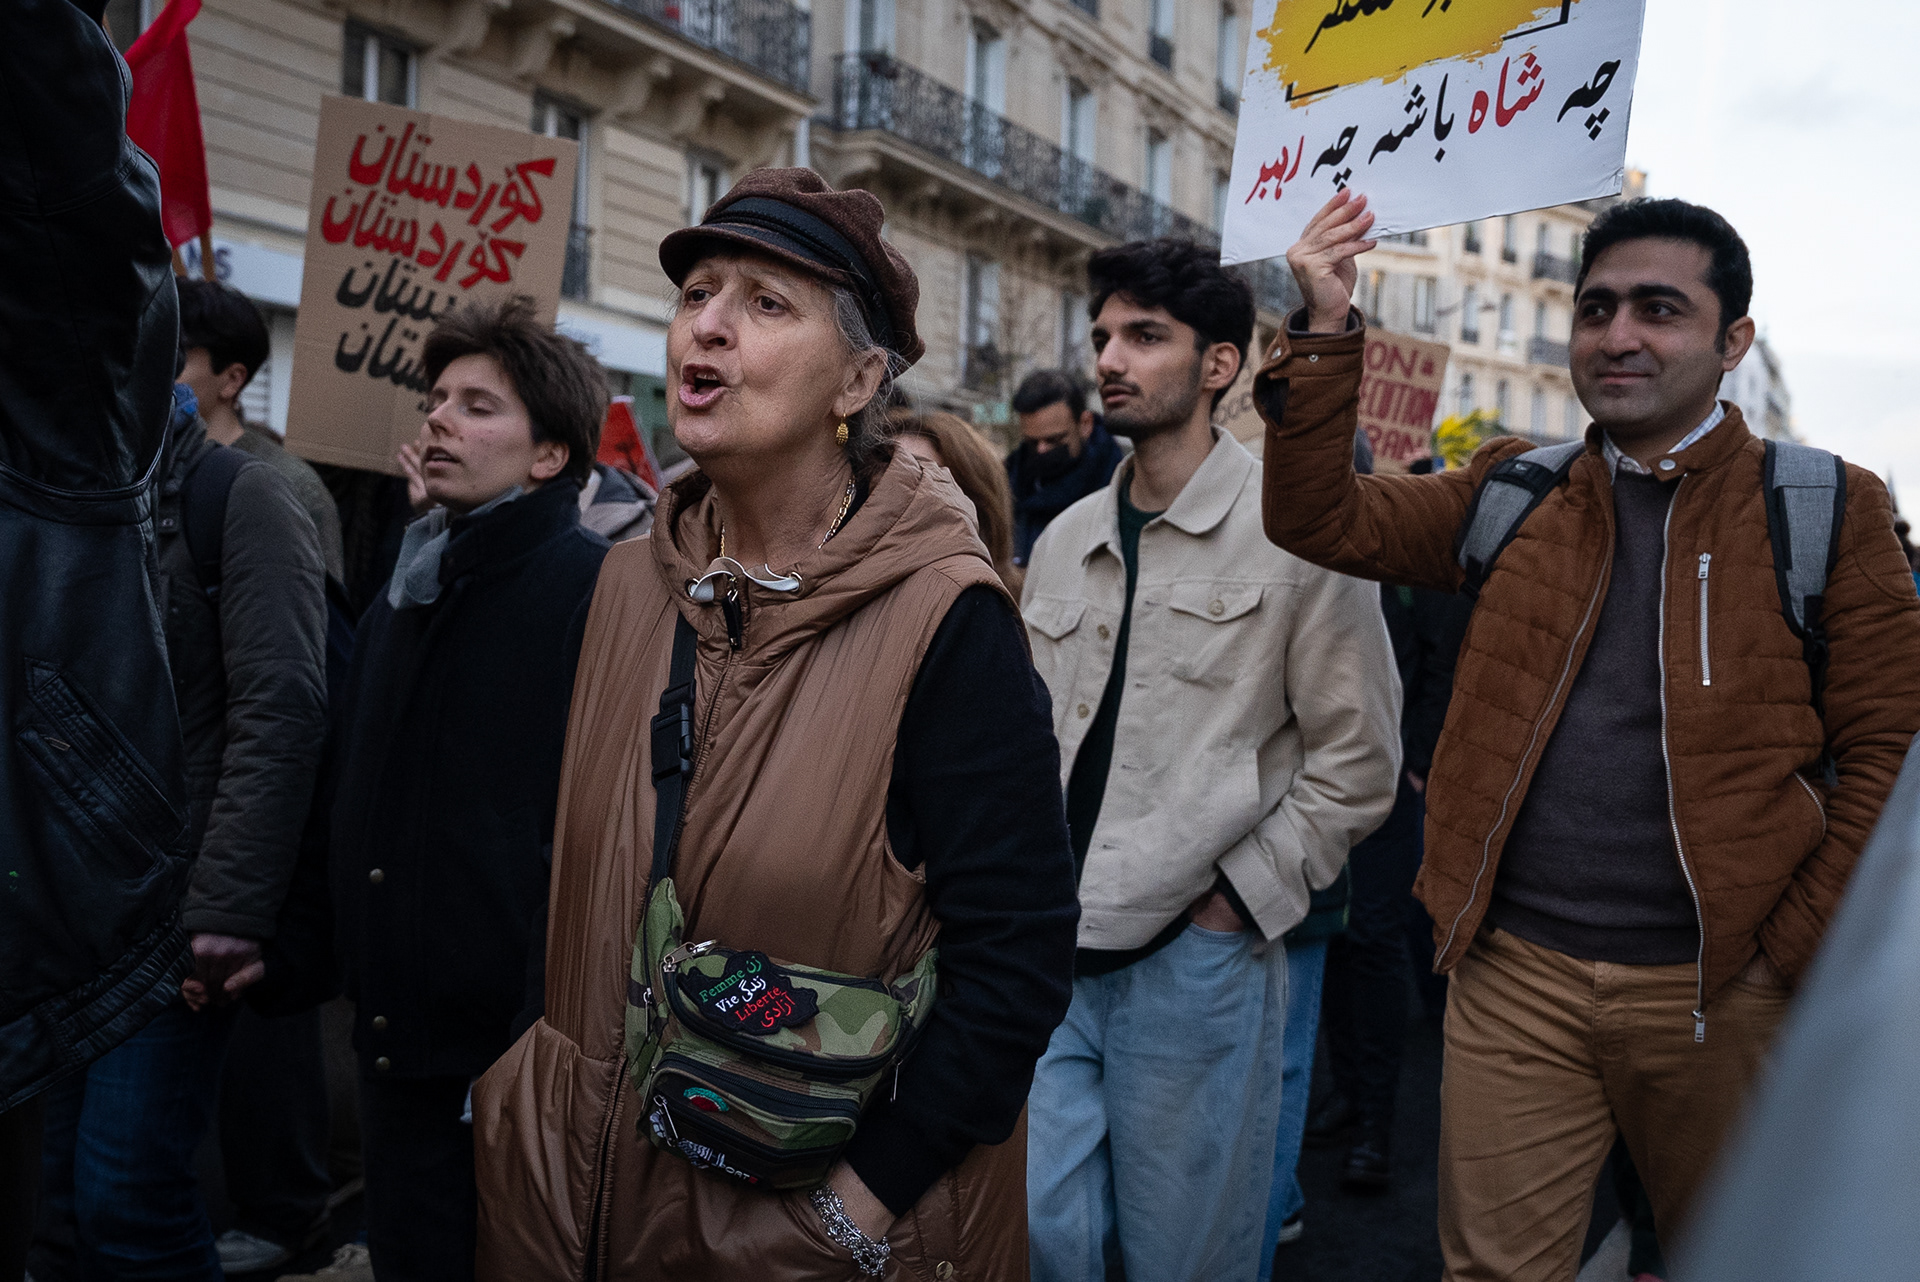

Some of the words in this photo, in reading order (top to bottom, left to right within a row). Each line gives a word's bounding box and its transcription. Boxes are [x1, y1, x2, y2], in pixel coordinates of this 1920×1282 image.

[1368, 73, 1455, 163] باشه
[1467, 52, 1545, 135] شاه
[1557, 59, 1621, 141] چه
[1245, 135, 1305, 204] رهبر
[1311, 125, 1359, 194] چه
[699, 969, 746, 1003] Femme
[738, 975, 767, 1003] زندگی
[746, 955, 762, 974] زن
[715, 995, 740, 1013] Vie
[760, 990, 796, 1028] آزادی
